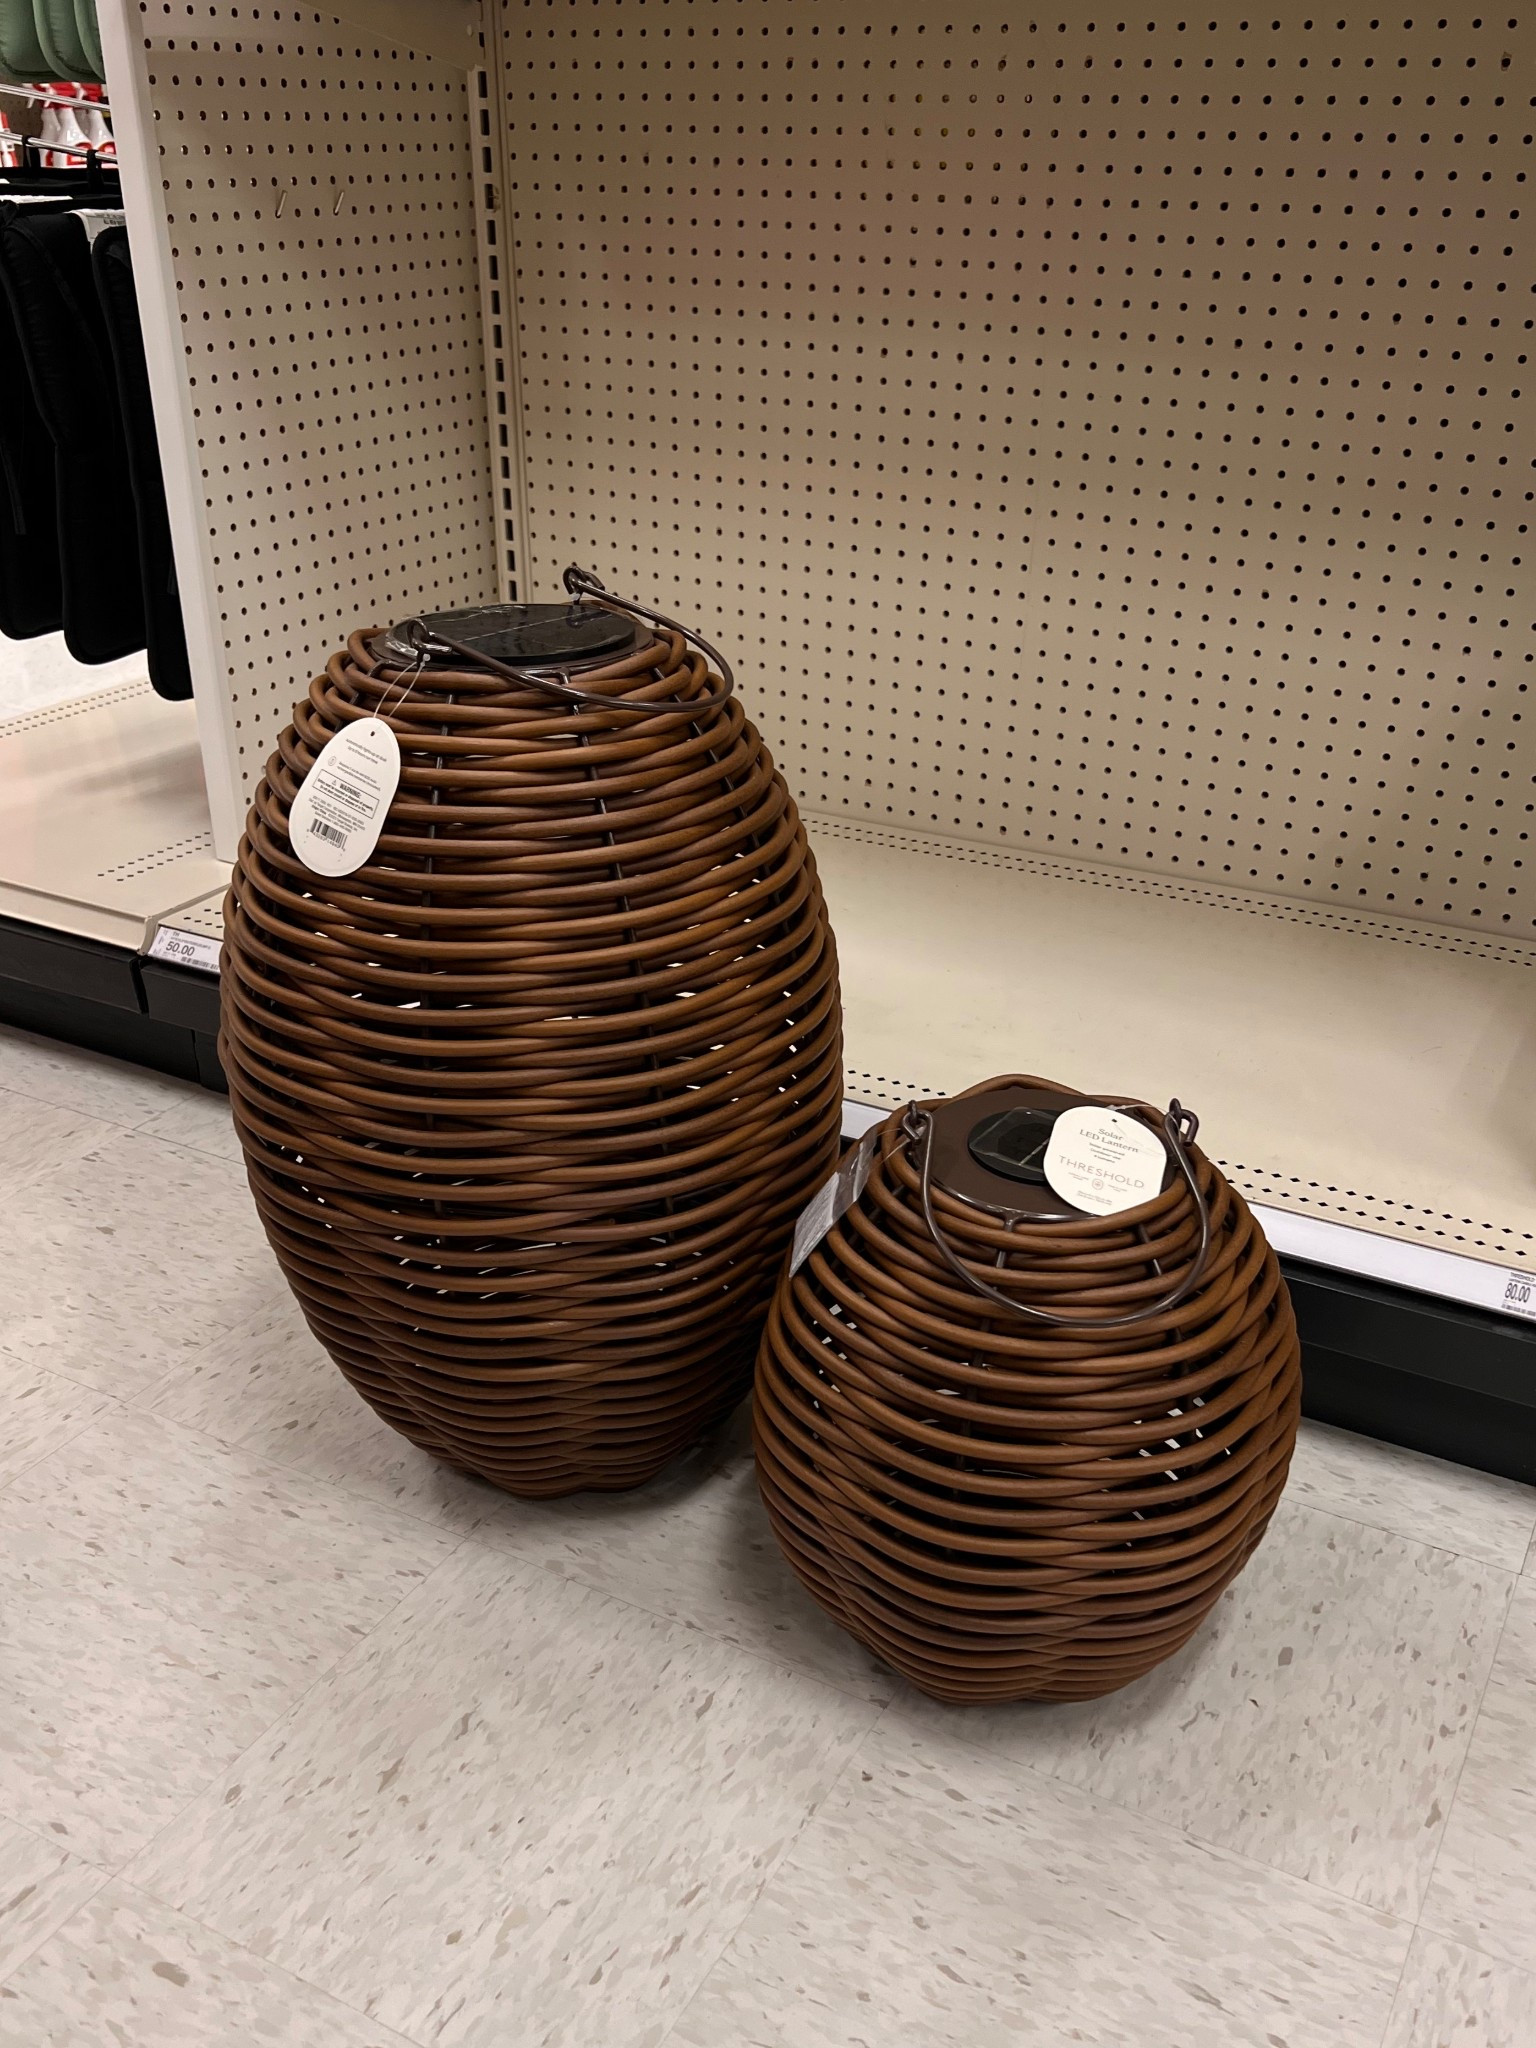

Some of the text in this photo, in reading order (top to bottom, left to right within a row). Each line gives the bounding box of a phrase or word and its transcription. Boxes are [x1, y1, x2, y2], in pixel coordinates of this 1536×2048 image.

[166, 941, 195, 956] 50.00
[1080, 1129, 1100, 1141] LED
[1102, 1136, 1139, 1153] Lantern
[1098, 1128, 1123, 1141] Solar
[1059, 1155, 1145, 1189] THRESHOLD
[1505, 1282, 1531, 1303] 80.00
